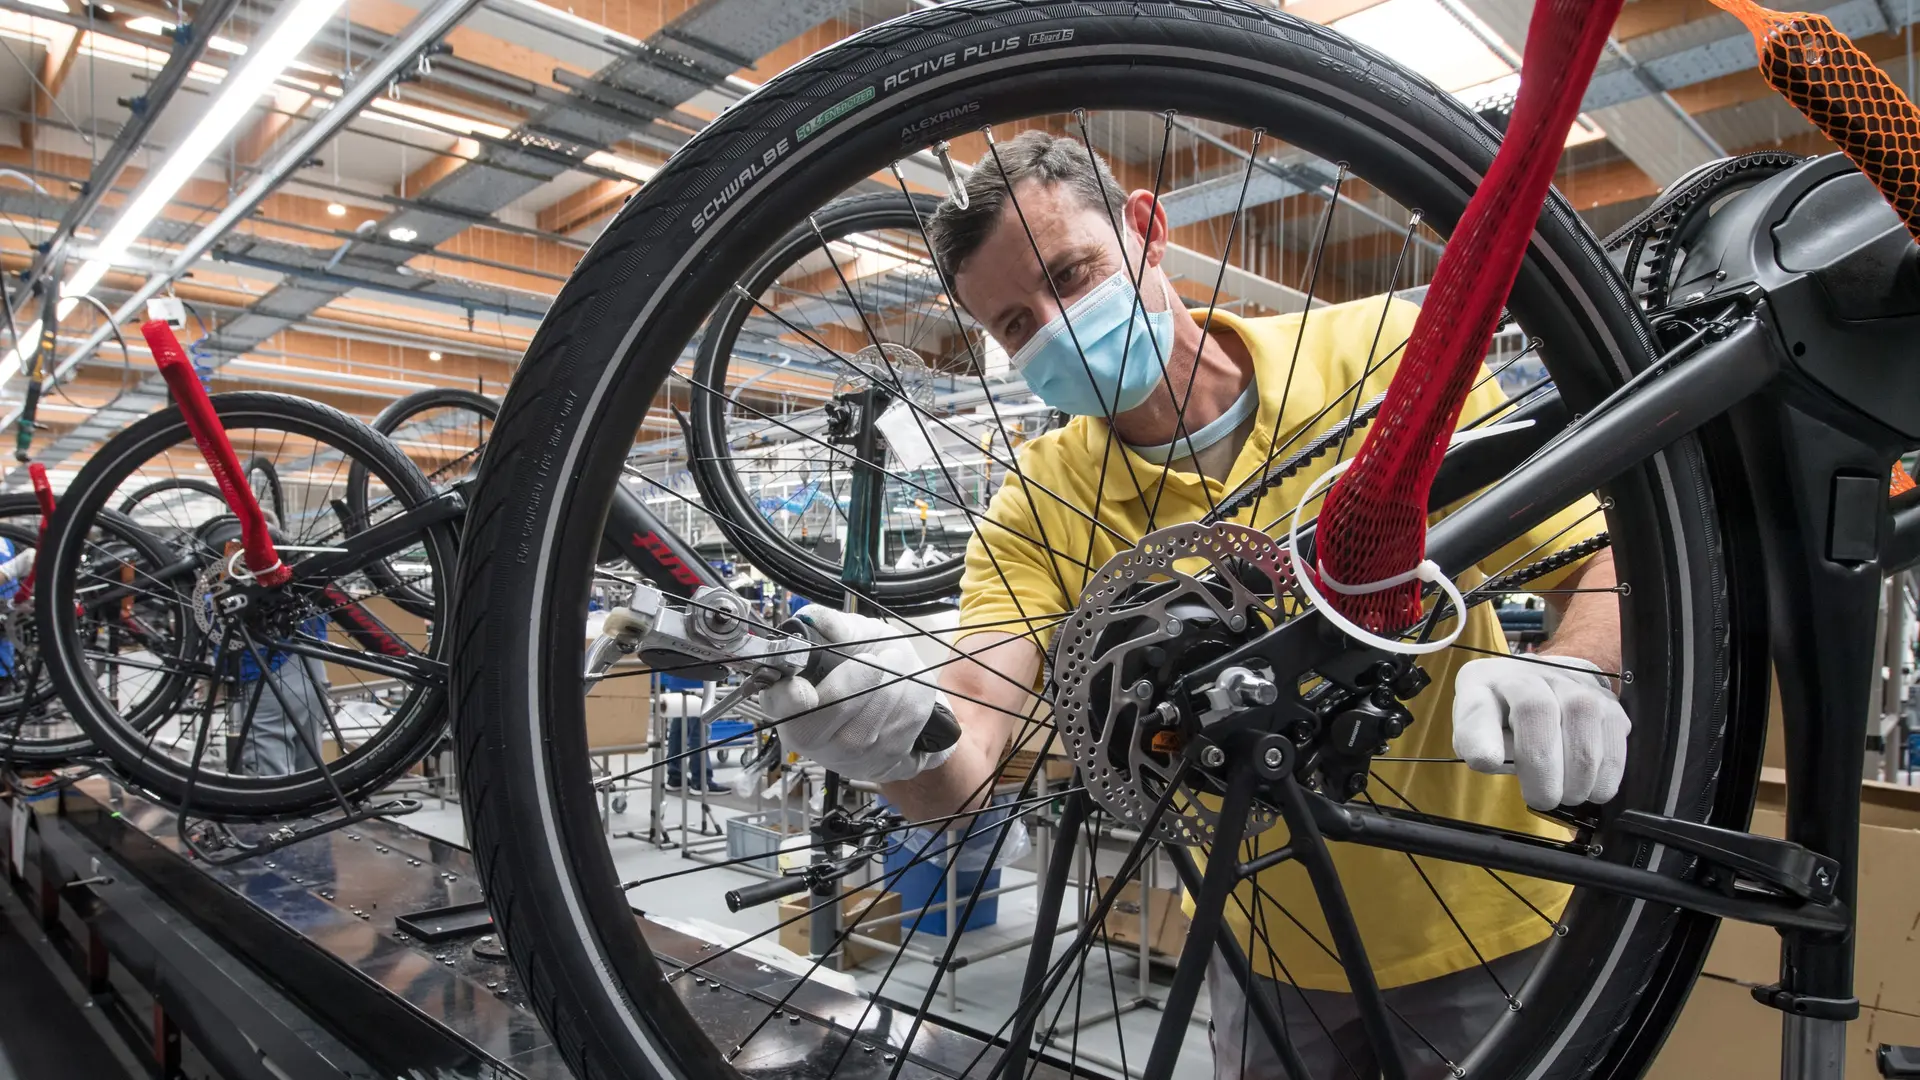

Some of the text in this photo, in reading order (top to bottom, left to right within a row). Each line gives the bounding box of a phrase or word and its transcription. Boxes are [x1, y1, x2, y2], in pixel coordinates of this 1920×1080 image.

[1318, 56, 1412, 107] SCHWALBE
[691, 137, 790, 234] SCHWALBE
[797, 122, 812, 140] 50
[824, 89, 873, 120] ENERGIZER
[884, 52, 956, 92] ACTIVE
[963, 36, 1020, 62] PLUS
[901, 101, 980, 138] ALEXRIMS
